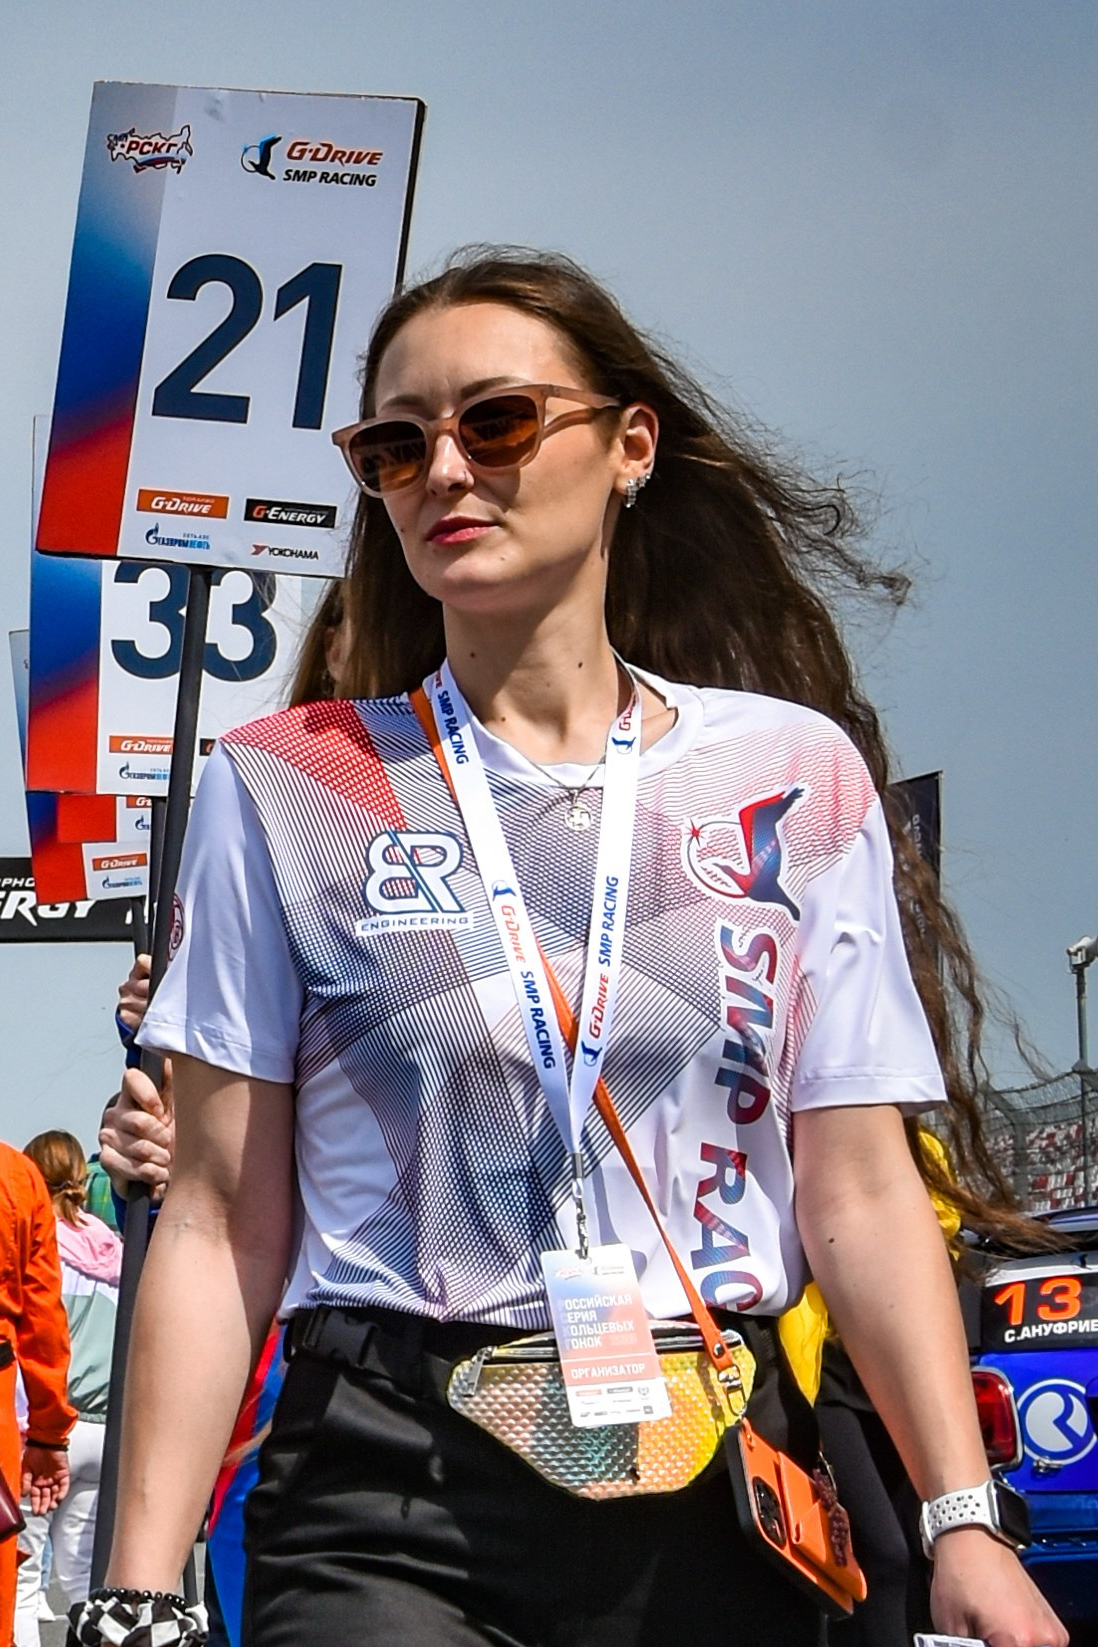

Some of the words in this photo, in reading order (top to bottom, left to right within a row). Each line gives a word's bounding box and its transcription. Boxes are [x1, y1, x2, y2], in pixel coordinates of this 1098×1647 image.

[283, 169, 318, 184] SMP
[319, 171, 377, 187] RACING
[151, 254, 342, 430] 21
[268, 546, 319, 561] YOKOHAMA
[111, 560, 277, 682] 33
[437, 690, 453, 718] SMP
[444, 717, 469, 765] RACING
[361, 917, 469, 932] ENGINEERING
[602, 876, 619, 932] RACING
[598, 933, 614, 967] SMP
[521, 971, 540, 1004] SMP
[530, 1007, 556, 1069] RACING
[715, 924, 778, 1125] SMP
[690, 1141, 764, 1311] RAC
[994, 1276, 1081, 1326] 13
[570, 1363, 646, 1380] ОРГАНИЗАТОР
